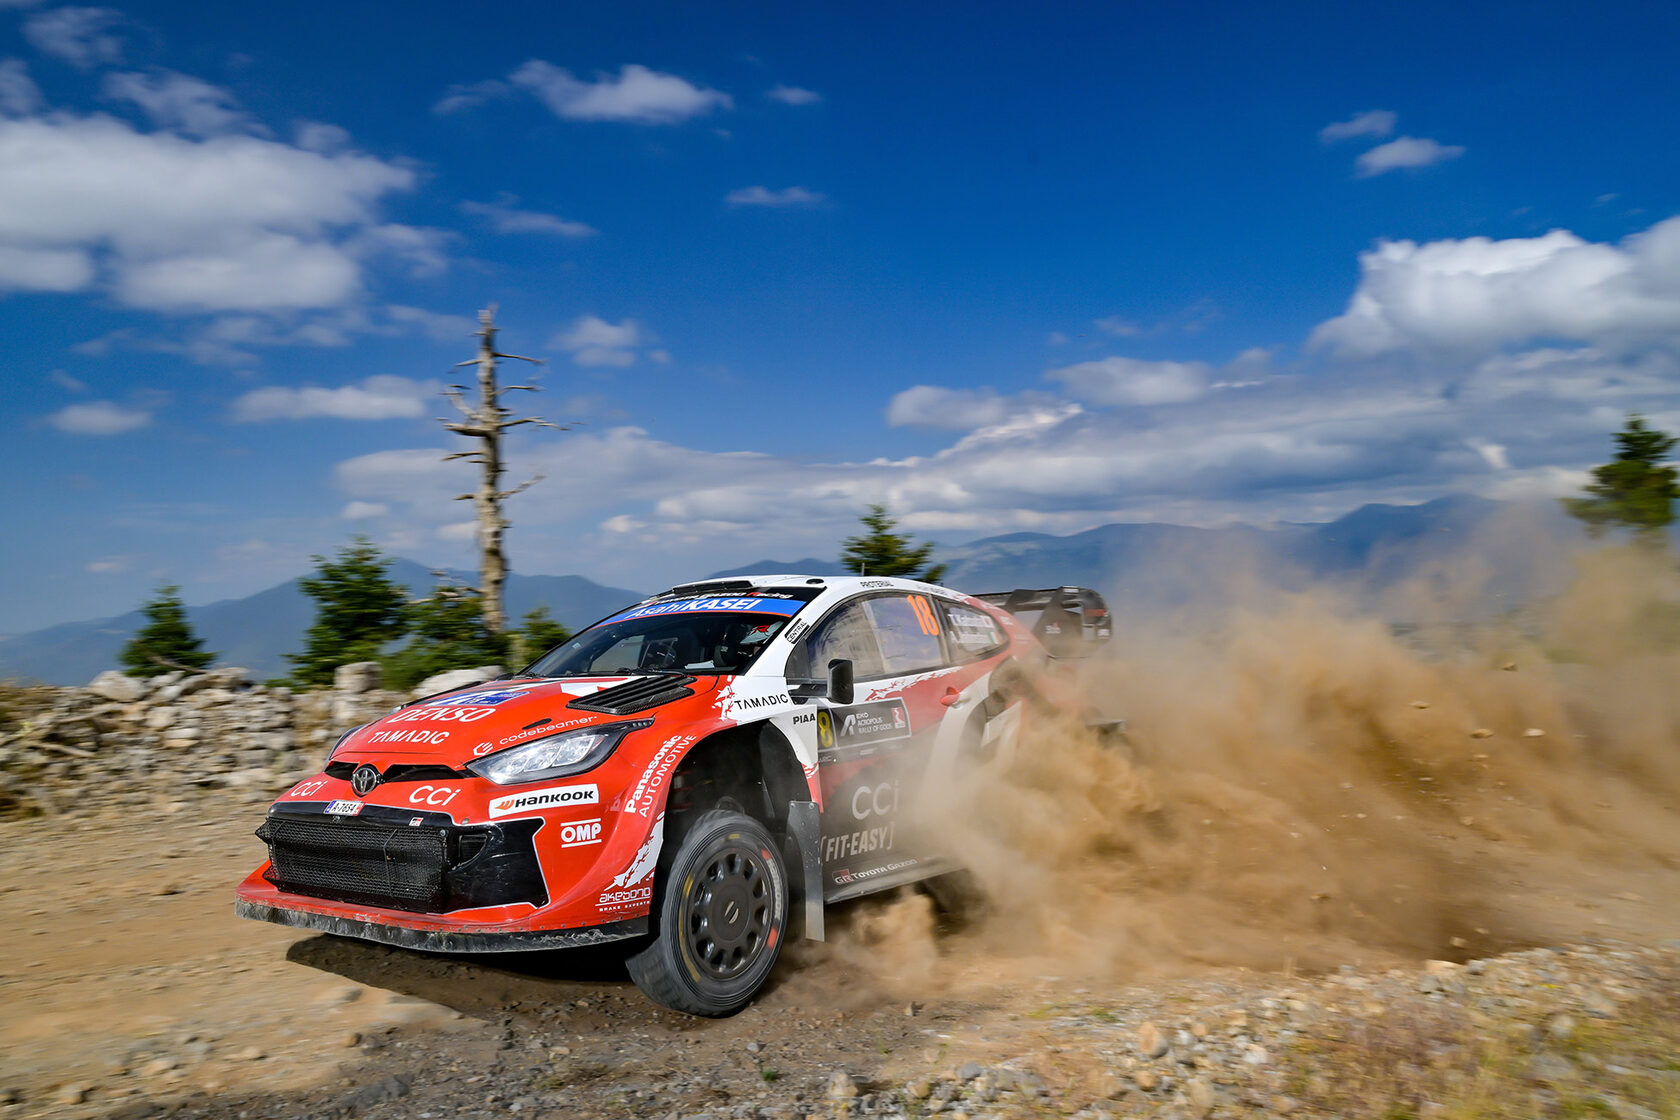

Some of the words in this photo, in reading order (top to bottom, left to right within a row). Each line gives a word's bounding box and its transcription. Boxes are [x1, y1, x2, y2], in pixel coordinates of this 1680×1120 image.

[906, 594, 939, 636] 18
[786, 621, 808, 643] CENTRAL
[734, 693, 789, 711] TAMADIC
[386, 706, 496, 724] DENSO
[792, 712, 816, 725] PIAA
[858, 717, 883, 726] ACROPOLIS
[367, 729, 450, 745] TAMADIC
[499, 716, 598, 746] codebeamer
[624, 735, 682, 814] Panasonic
[638, 734, 697, 818] AUTOMOTIVE
[560, 822, 602, 843] OMP
[599, 887, 651, 903] akebono
